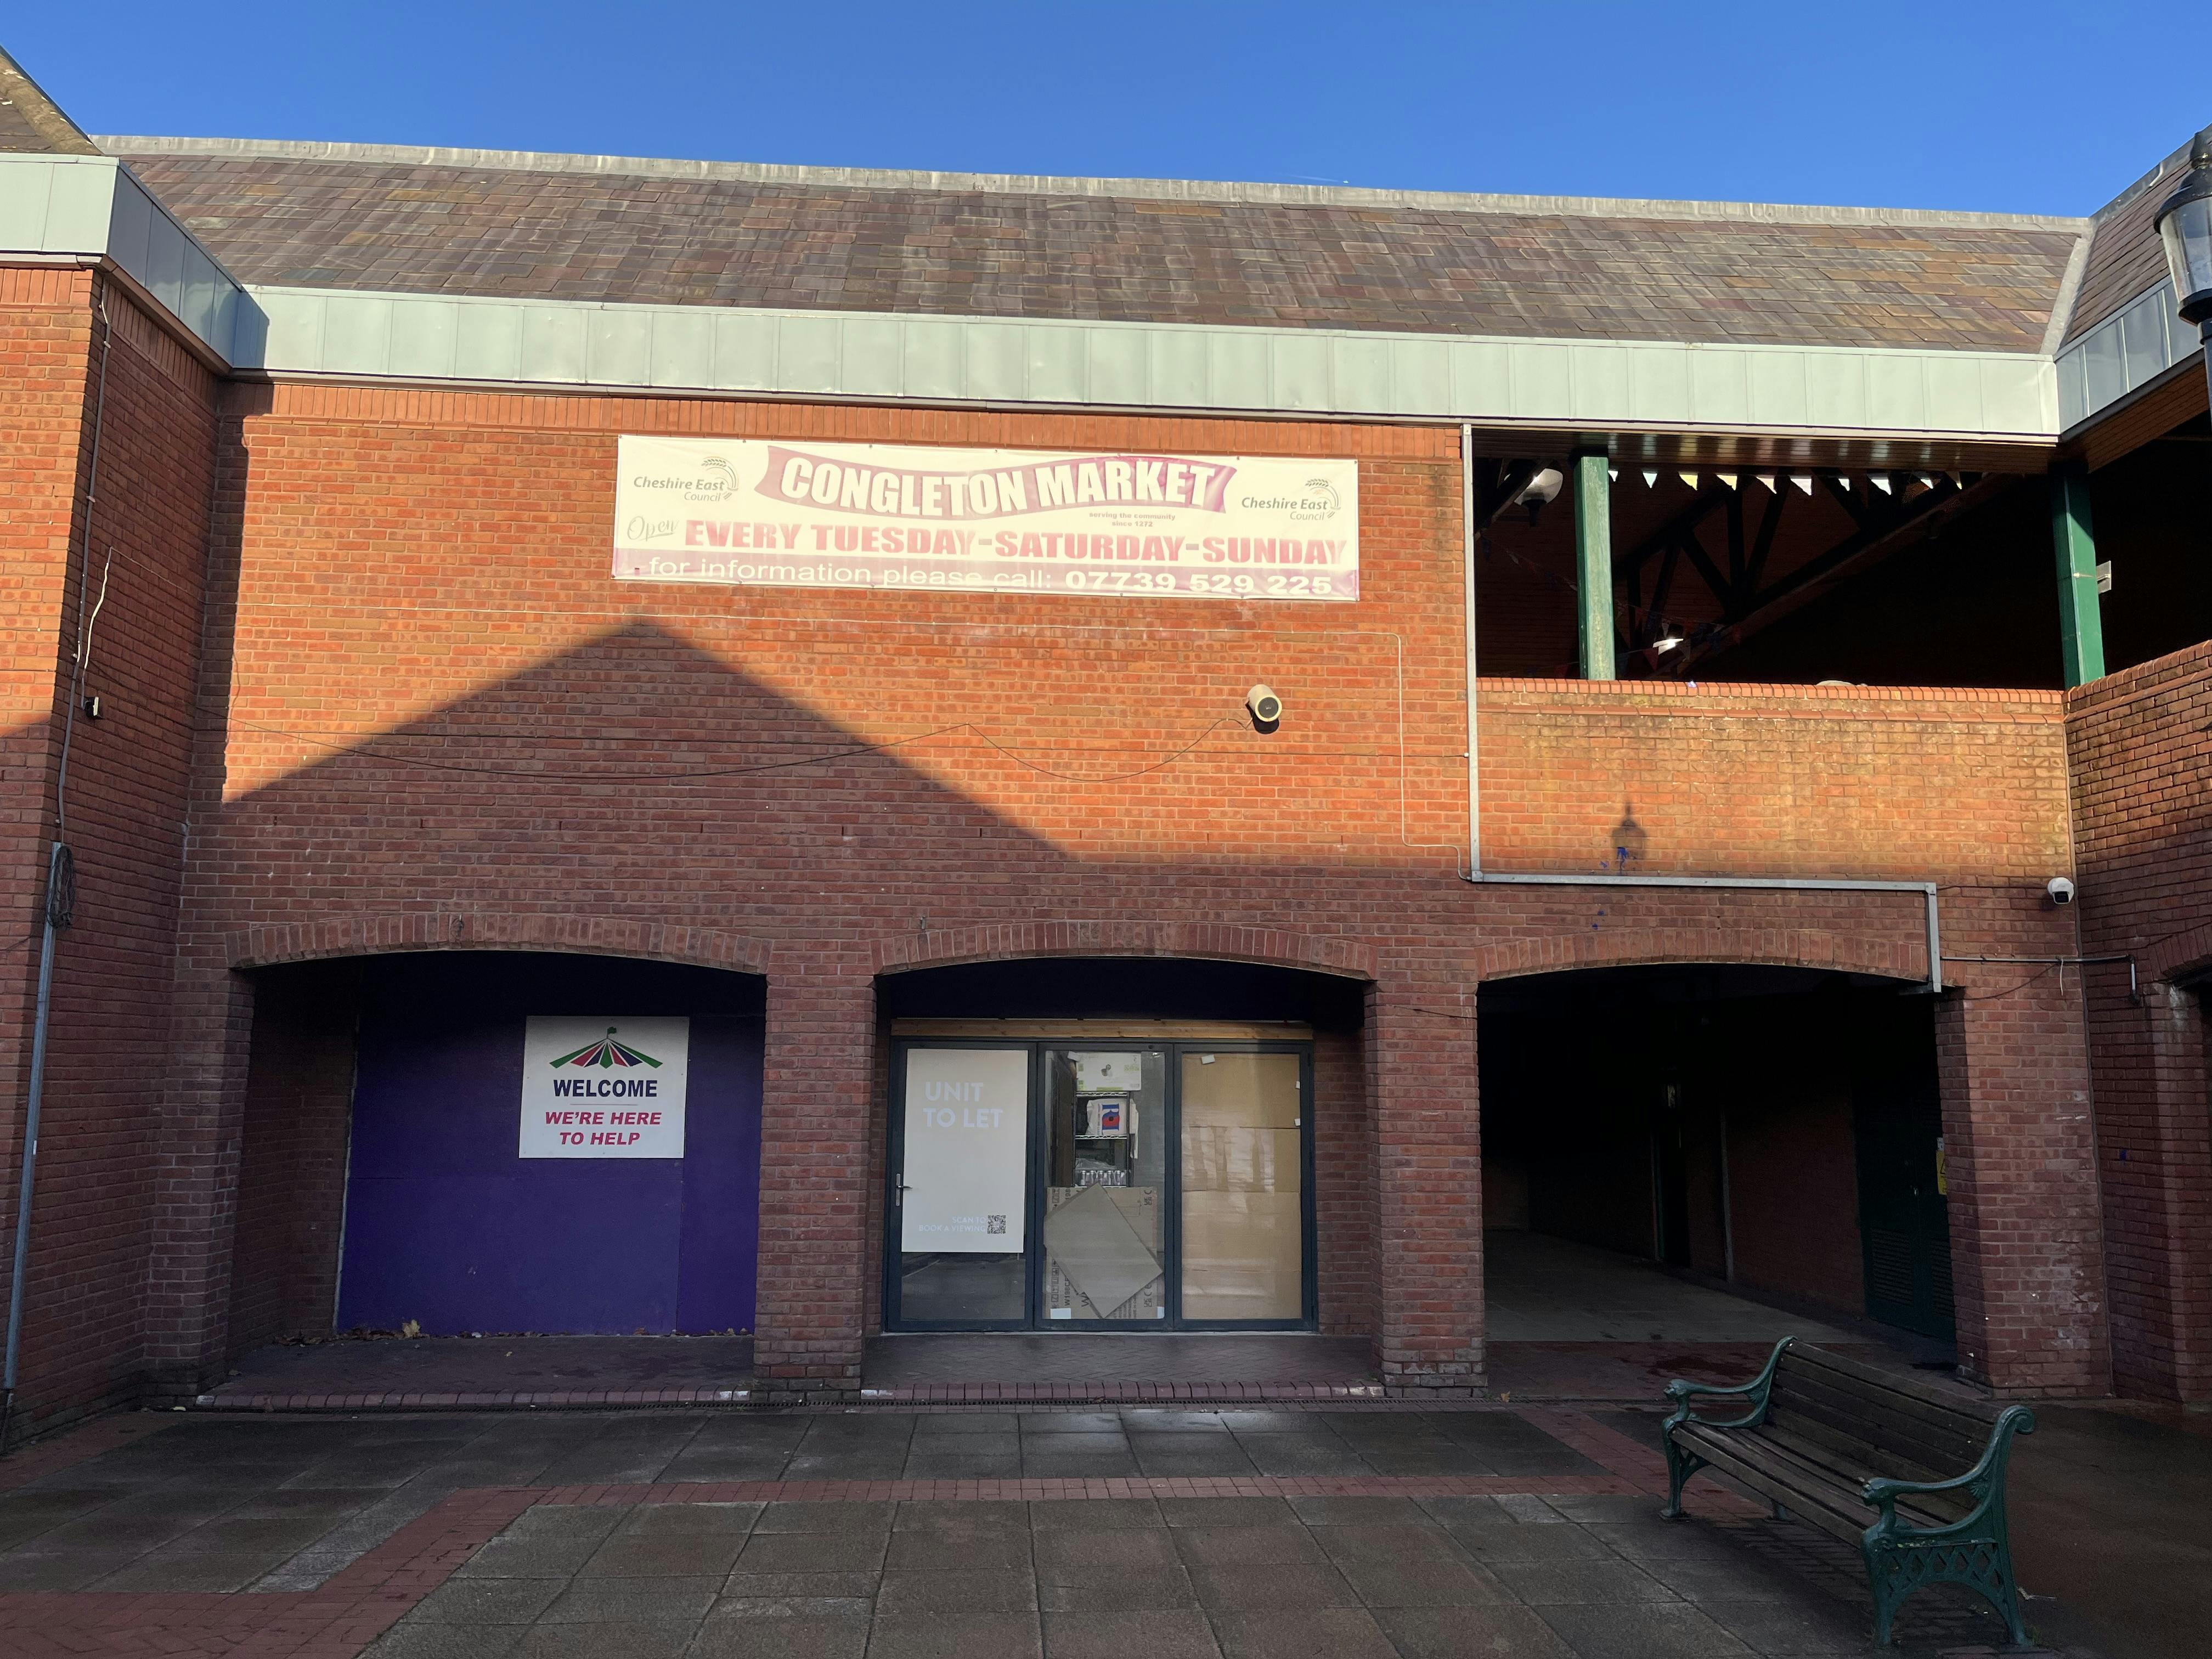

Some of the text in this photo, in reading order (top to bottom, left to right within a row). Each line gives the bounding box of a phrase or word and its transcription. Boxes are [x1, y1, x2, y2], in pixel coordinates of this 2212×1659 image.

[634, 476, 725, 491] Cheshire East
[781, 457, 1215, 516] CONGLETON MARKET
[684, 492, 721, 501] Council
[1242, 497, 1328, 510] Cheshire East
[1290, 511, 1324, 520] Council
[627, 516, 680, 541] Open
[685, 520, 801, 549] EVERY
[649, 556, 1332, 594] for information please call: 07739 529 225
[553, 1079, 658, 1097] WELCOME
[925, 1081, 984, 1102] UNIT
[545, 1111, 662, 1125] WE’RE HERE
[923, 1107, 1003, 1128] TO LET
[560, 1132, 641, 1146] TO HELP
